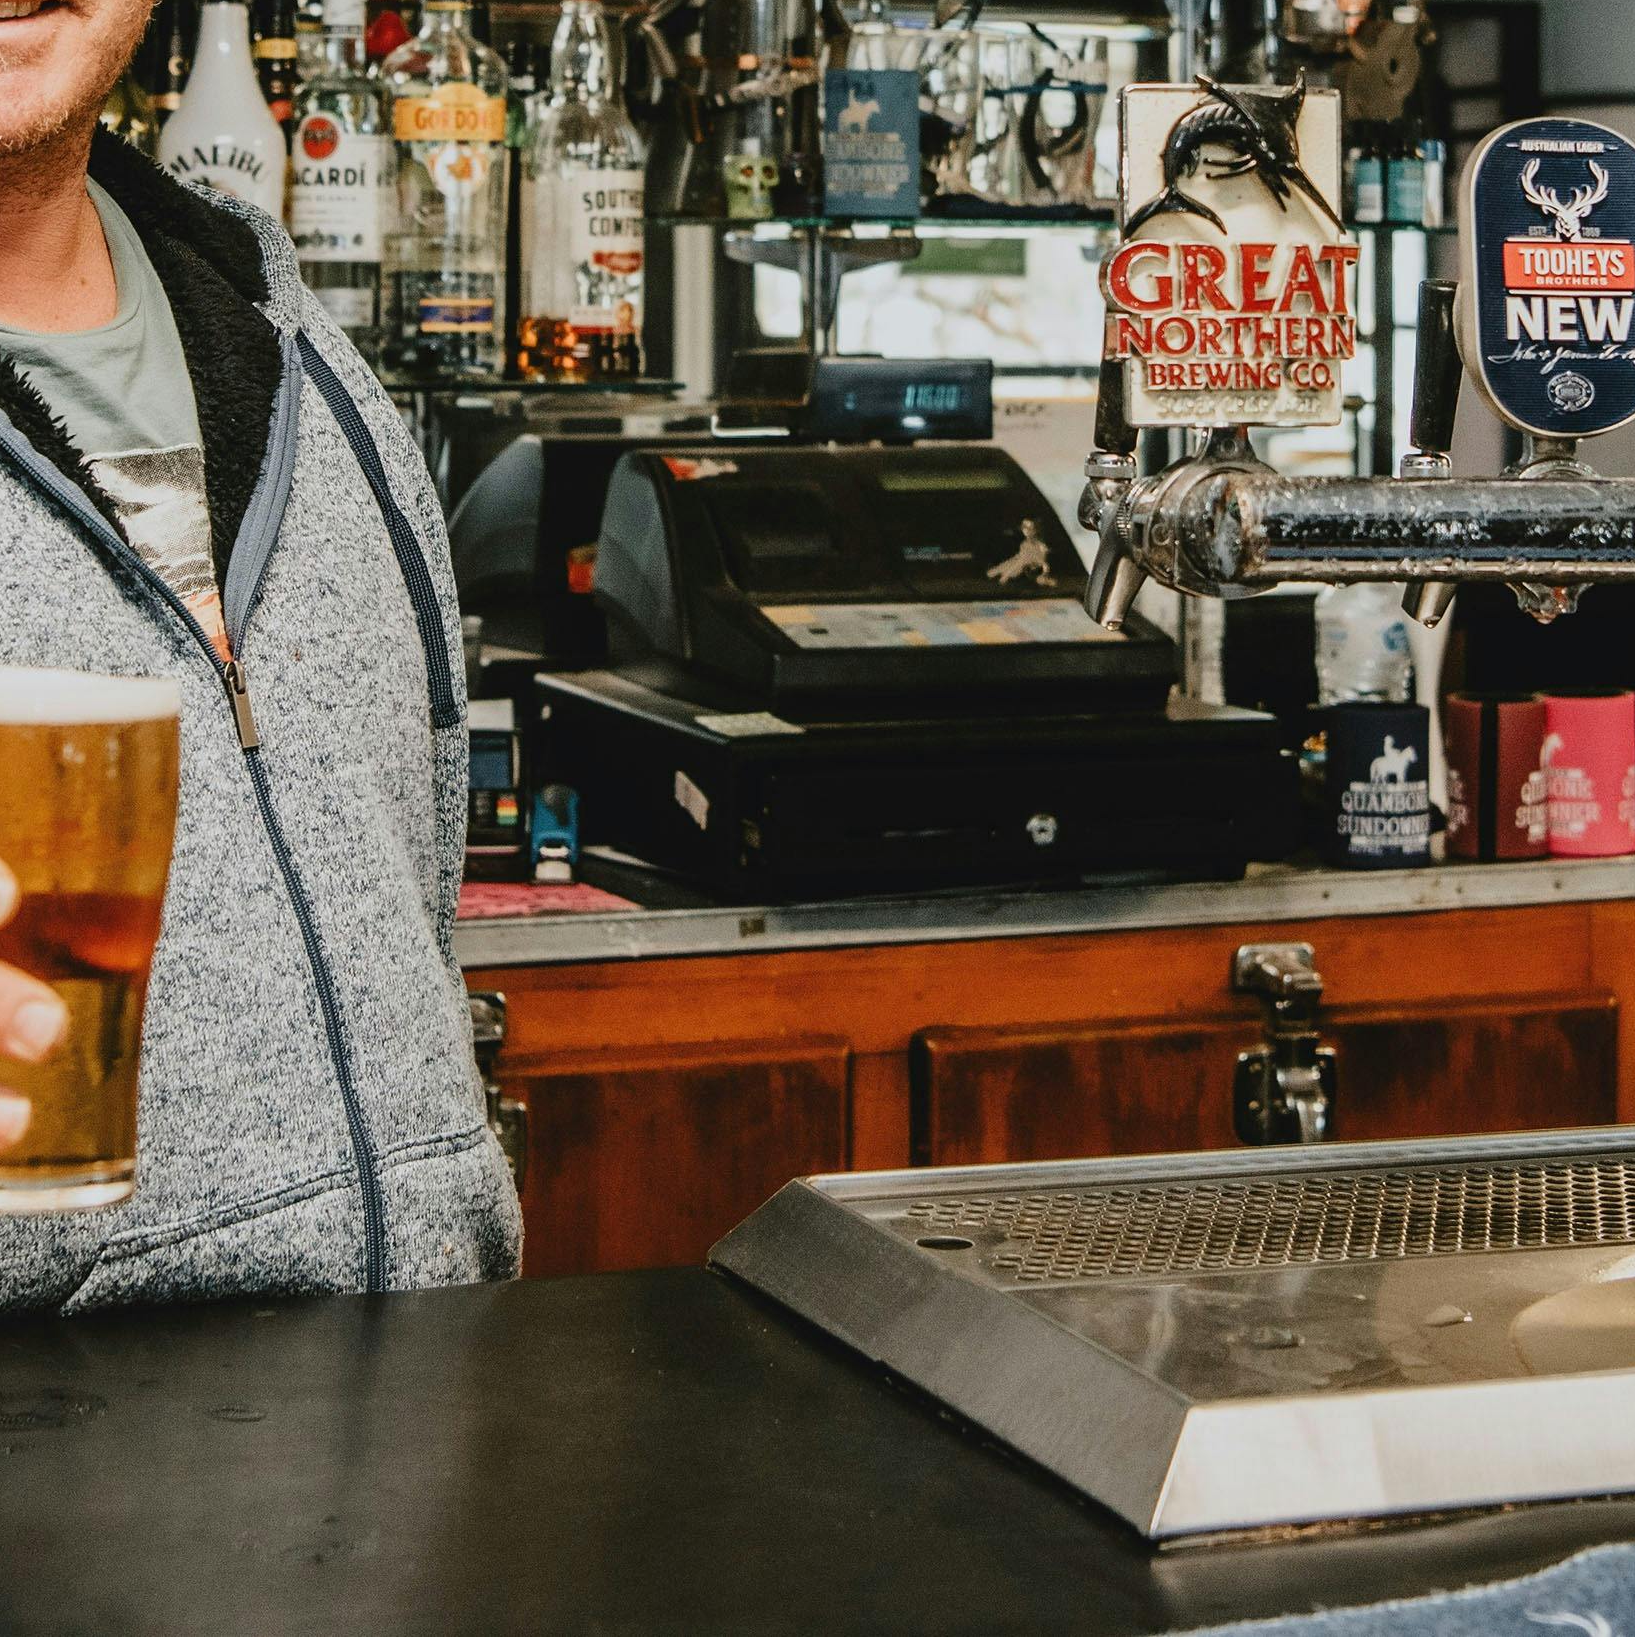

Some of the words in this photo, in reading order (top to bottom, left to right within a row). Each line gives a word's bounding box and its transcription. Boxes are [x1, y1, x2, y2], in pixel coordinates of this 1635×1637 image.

[1108, 241, 1361, 315] GREAT
[1518, 248, 1626, 277] TOOHEYS
[1536, 276, 1608, 286] BROTHERS
[1505, 296, 1635, 342] NEW
[1116, 316, 1355, 359] NORTHERN
[1148, 363, 1282, 390] BREWING
[1291, 361, 1337, 391] CO.
